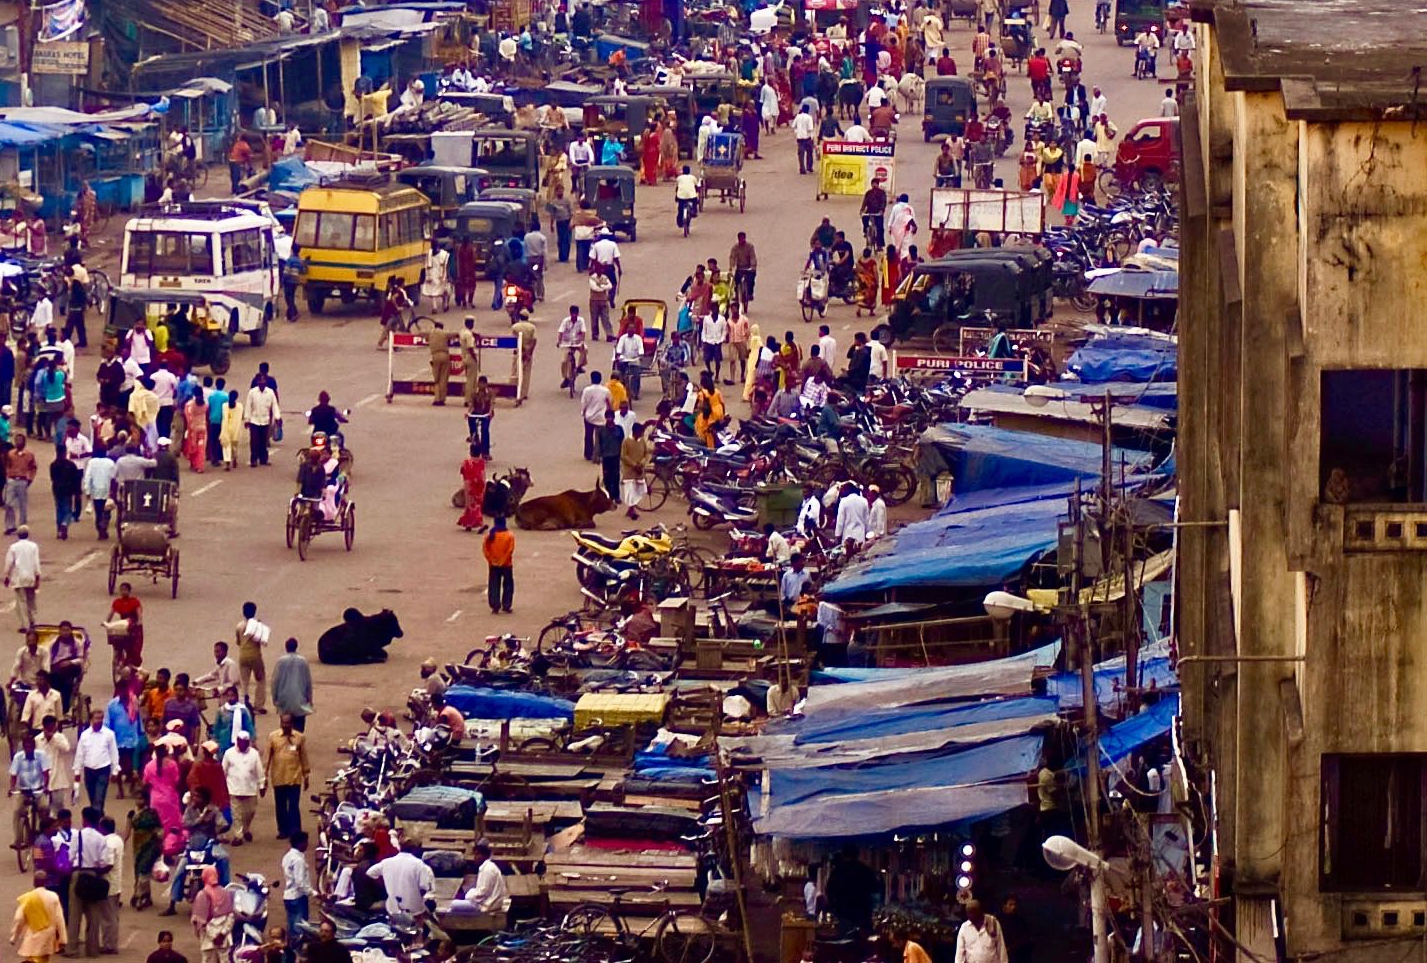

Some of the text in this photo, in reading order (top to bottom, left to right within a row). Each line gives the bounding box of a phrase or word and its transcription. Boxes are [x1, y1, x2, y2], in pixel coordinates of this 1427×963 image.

[832, 168, 853, 179] idea
[917, 359, 1004, 370] PURI POLICE
